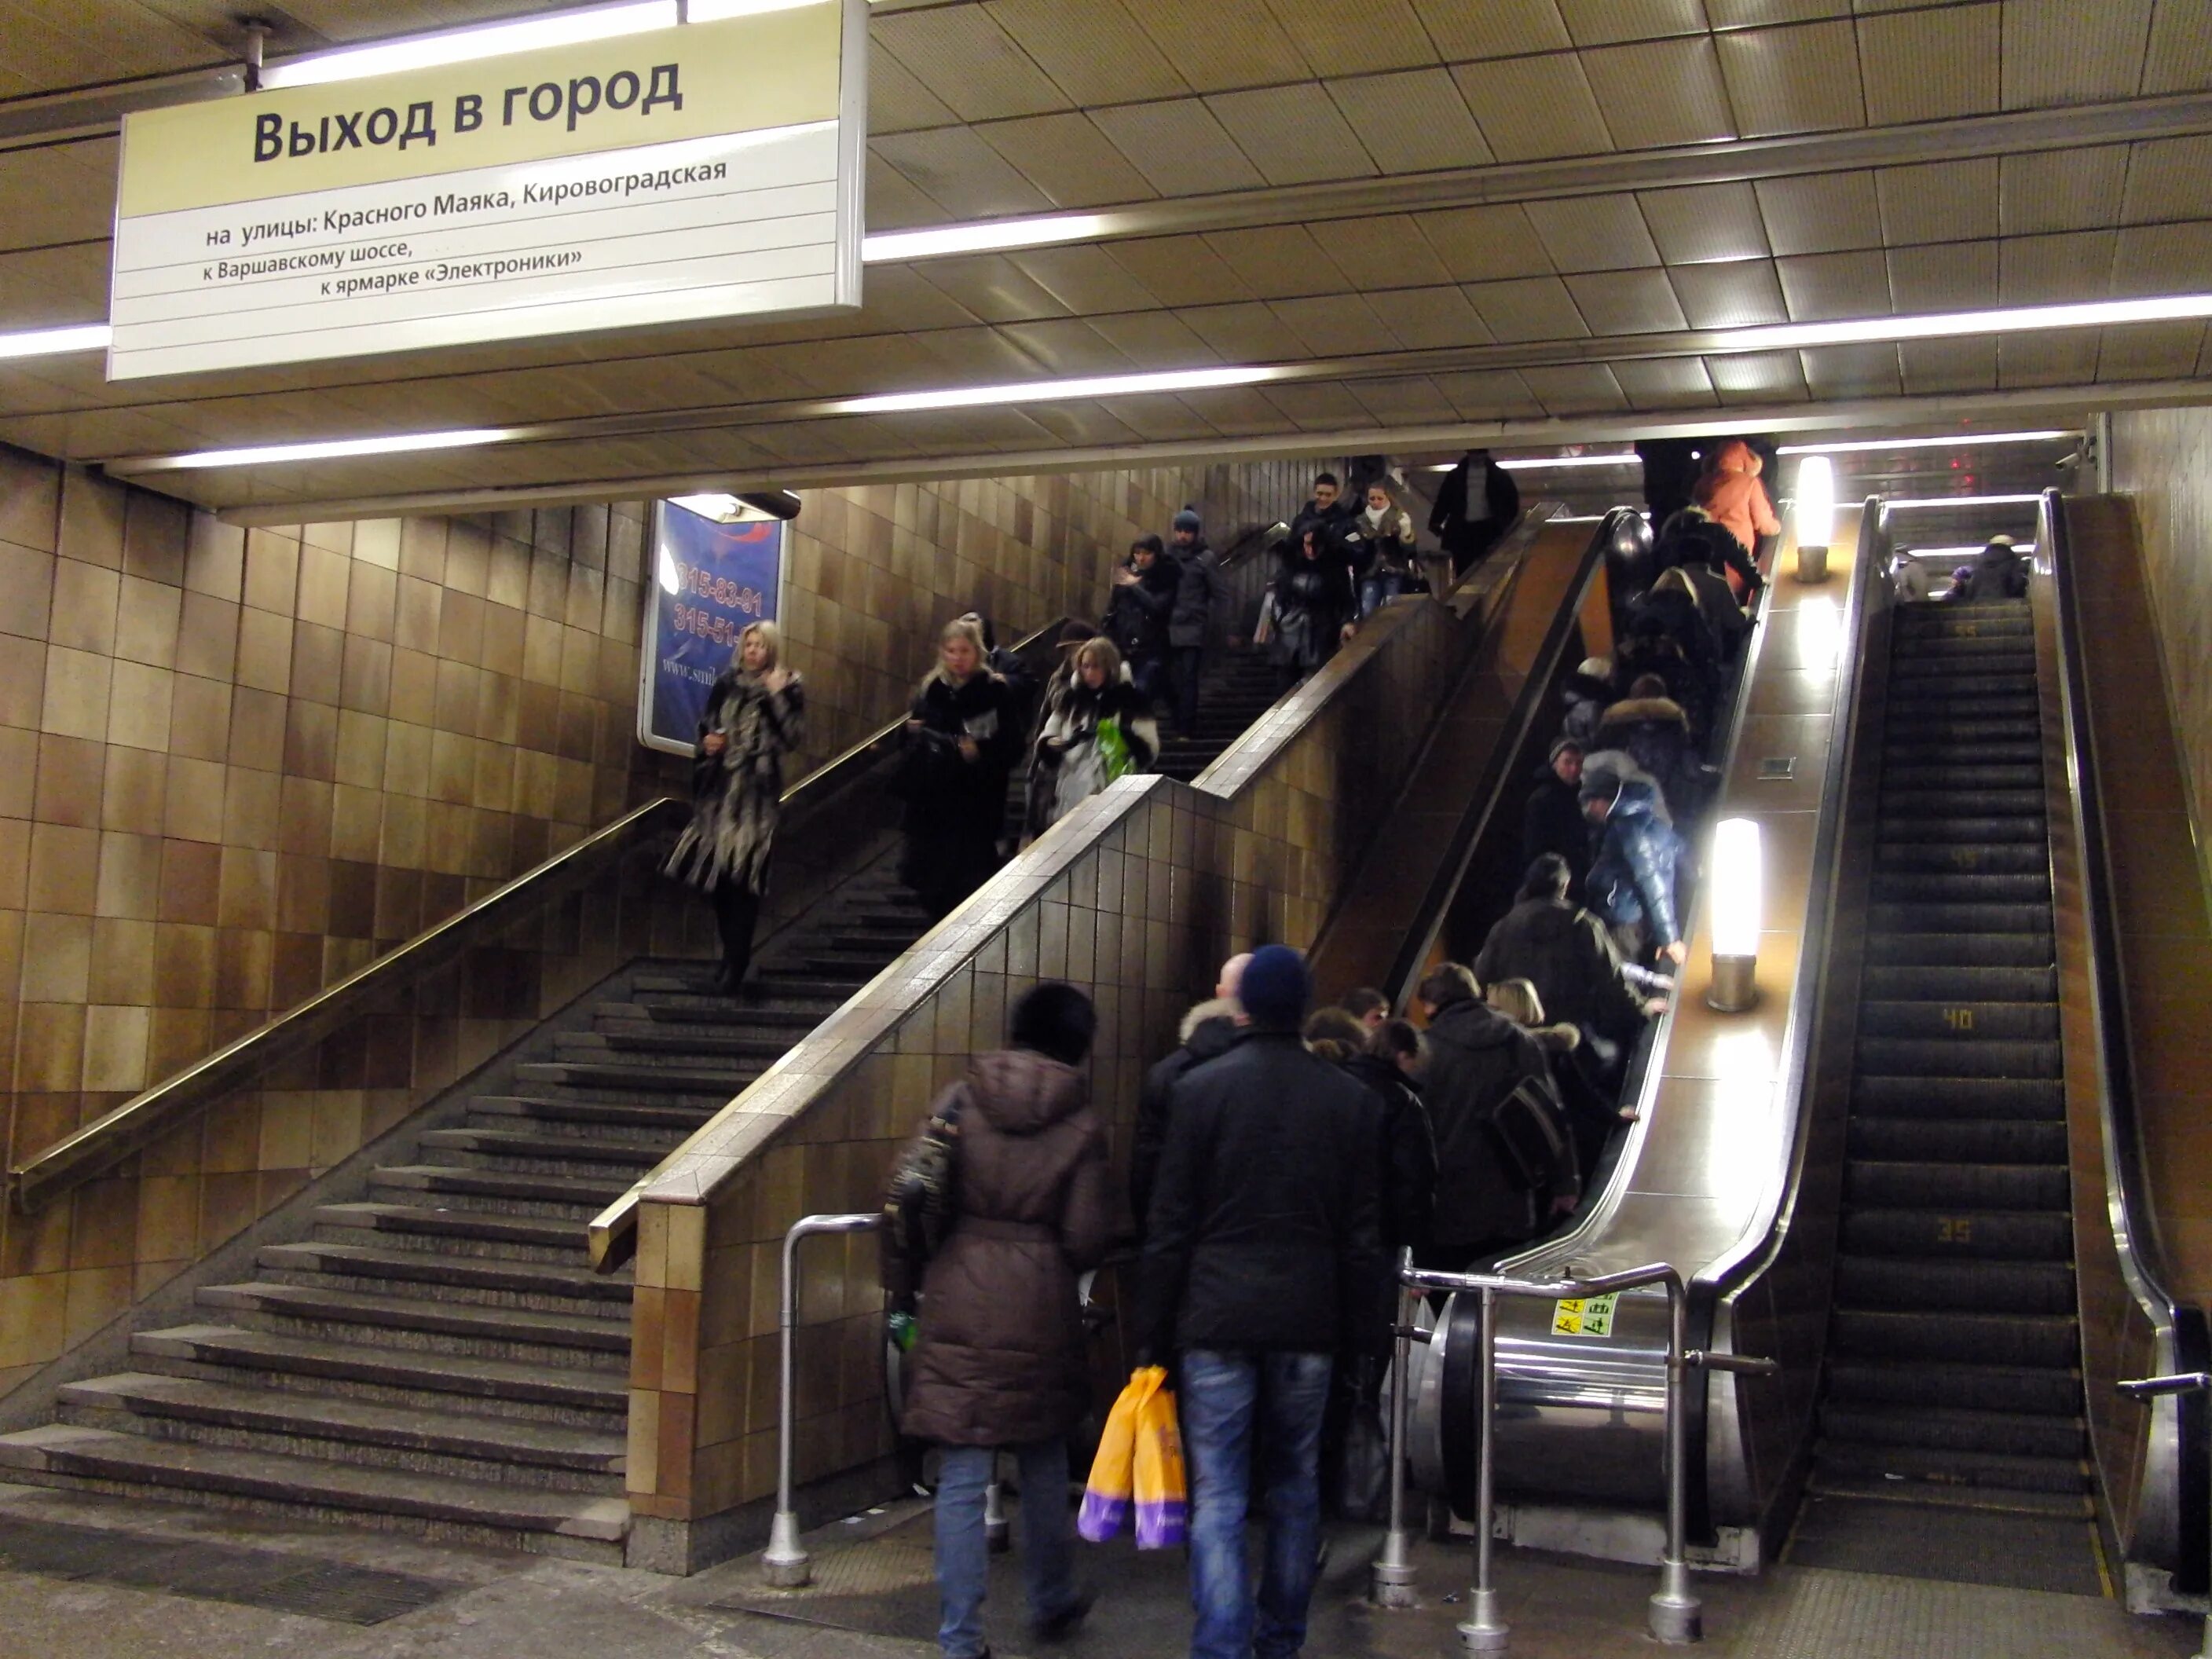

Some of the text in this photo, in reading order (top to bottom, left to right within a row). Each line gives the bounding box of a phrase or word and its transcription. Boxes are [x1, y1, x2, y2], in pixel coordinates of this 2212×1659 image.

[255, 62, 683, 163] Выход в город
[207, 162, 727, 247] на улицы: Красного Маяка, Кировоградская
[203, 242, 413, 281] к Варшавскому шоссе,
[320, 251, 583, 298] к ярмарке «Электроники»
[673, 603, 745, 648] 315-51-
[663, 658, 716, 687] www.smil
